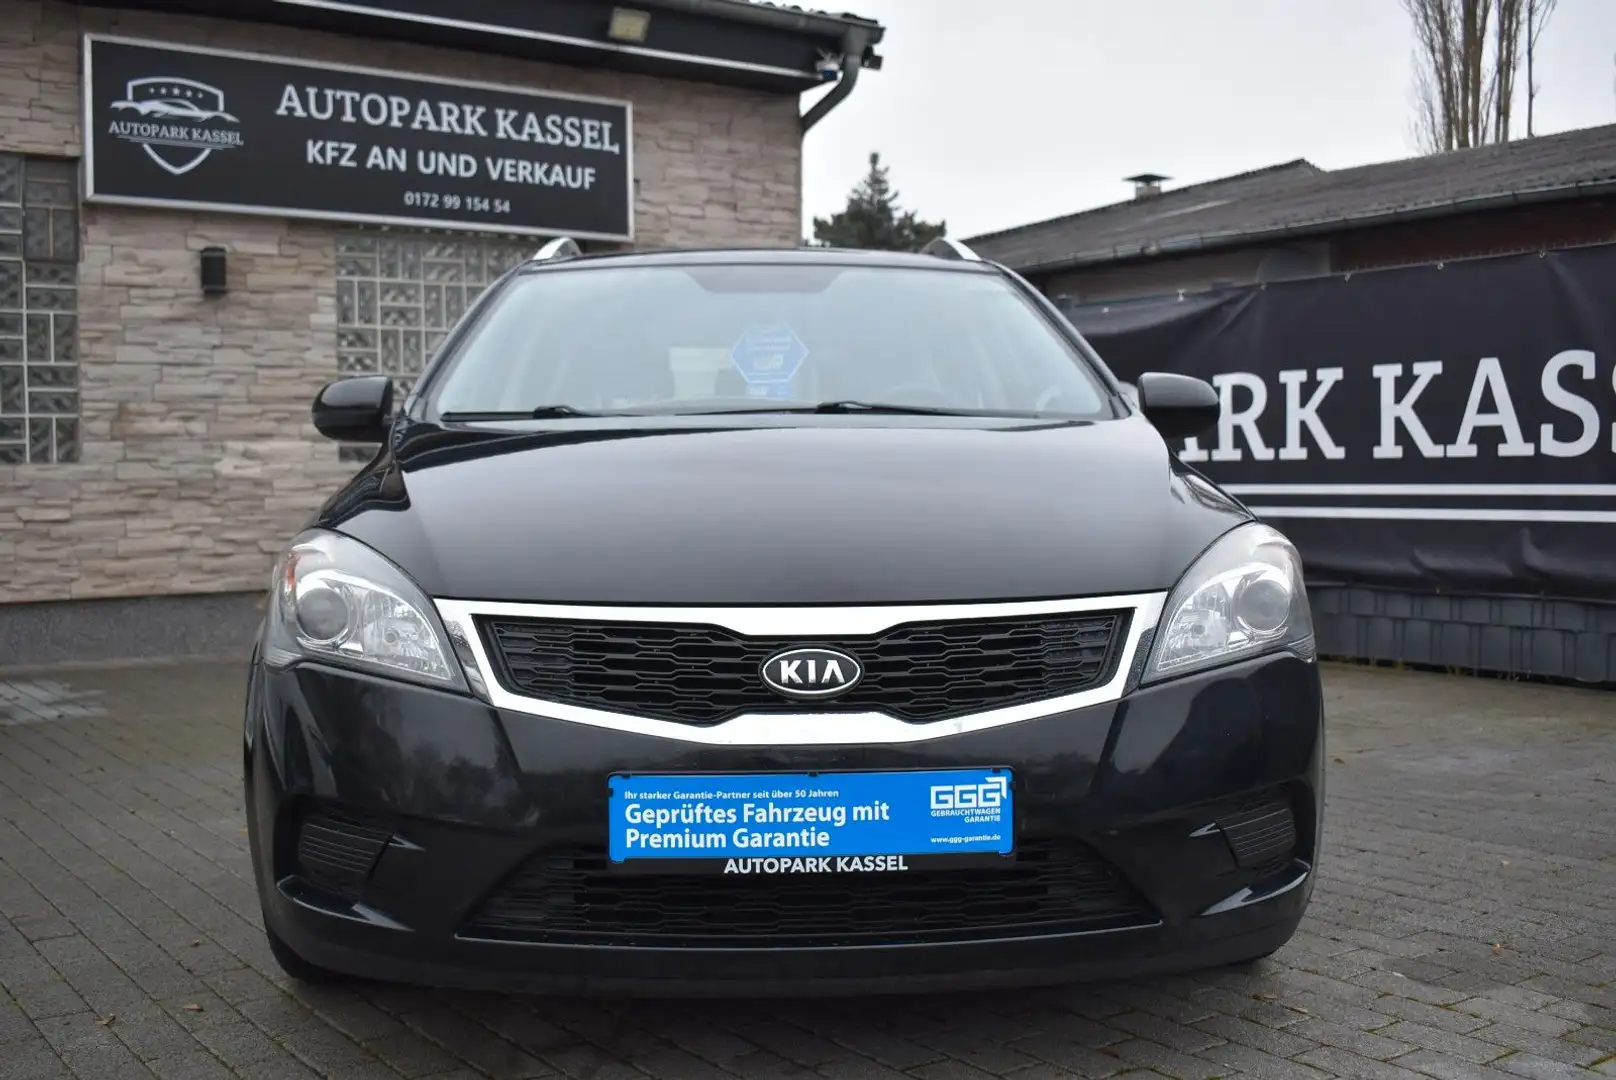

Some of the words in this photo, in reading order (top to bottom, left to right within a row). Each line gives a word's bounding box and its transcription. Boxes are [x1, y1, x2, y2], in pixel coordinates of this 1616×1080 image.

[275, 83, 487, 137] AUTOPARK
[494, 107, 620, 155] KASSEL
[108, 120, 188, 140] AUTOPARK
[306, 139, 357, 167] KFZ
[365, 145, 407, 172] AN
[417, 150, 477, 177] UND
[485, 156, 596, 190] VERKAUF
[404, 191, 439, 208] 0172
[465, 196, 490, 211] 154
[1179, 366, 1346, 462] RK
[1373, 349, 1616, 459] KAS
[779, 659, 846, 684] KIA
[624, 791, 637, 799] Ihr
[639, 791, 671, 800] starker
[673, 790, 751, 800] Garantie-Partner
[753, 790, 769, 799] seit
[771, 789, 792, 798] über
[794, 789, 806, 798] 50
[808, 788, 839, 798] Jahren
[930, 783, 1001, 809] GGG
[625, 803, 737, 829] Geprüftes
[743, 801, 846, 827] Fahrzeug
[853, 800, 889, 821] mit
[930, 807, 1001, 817] GEBRAUCHTWAGEN
[964, 815, 1001, 823] GARANTIE
[625, 828, 727, 848] Premium
[732, 826, 830, 848] Garantie
[930, 833, 1001, 844] www.ggg-garantie.de
[723, 857, 832, 874] AUTOPARK
[836, 855, 909, 872] KASSEL
